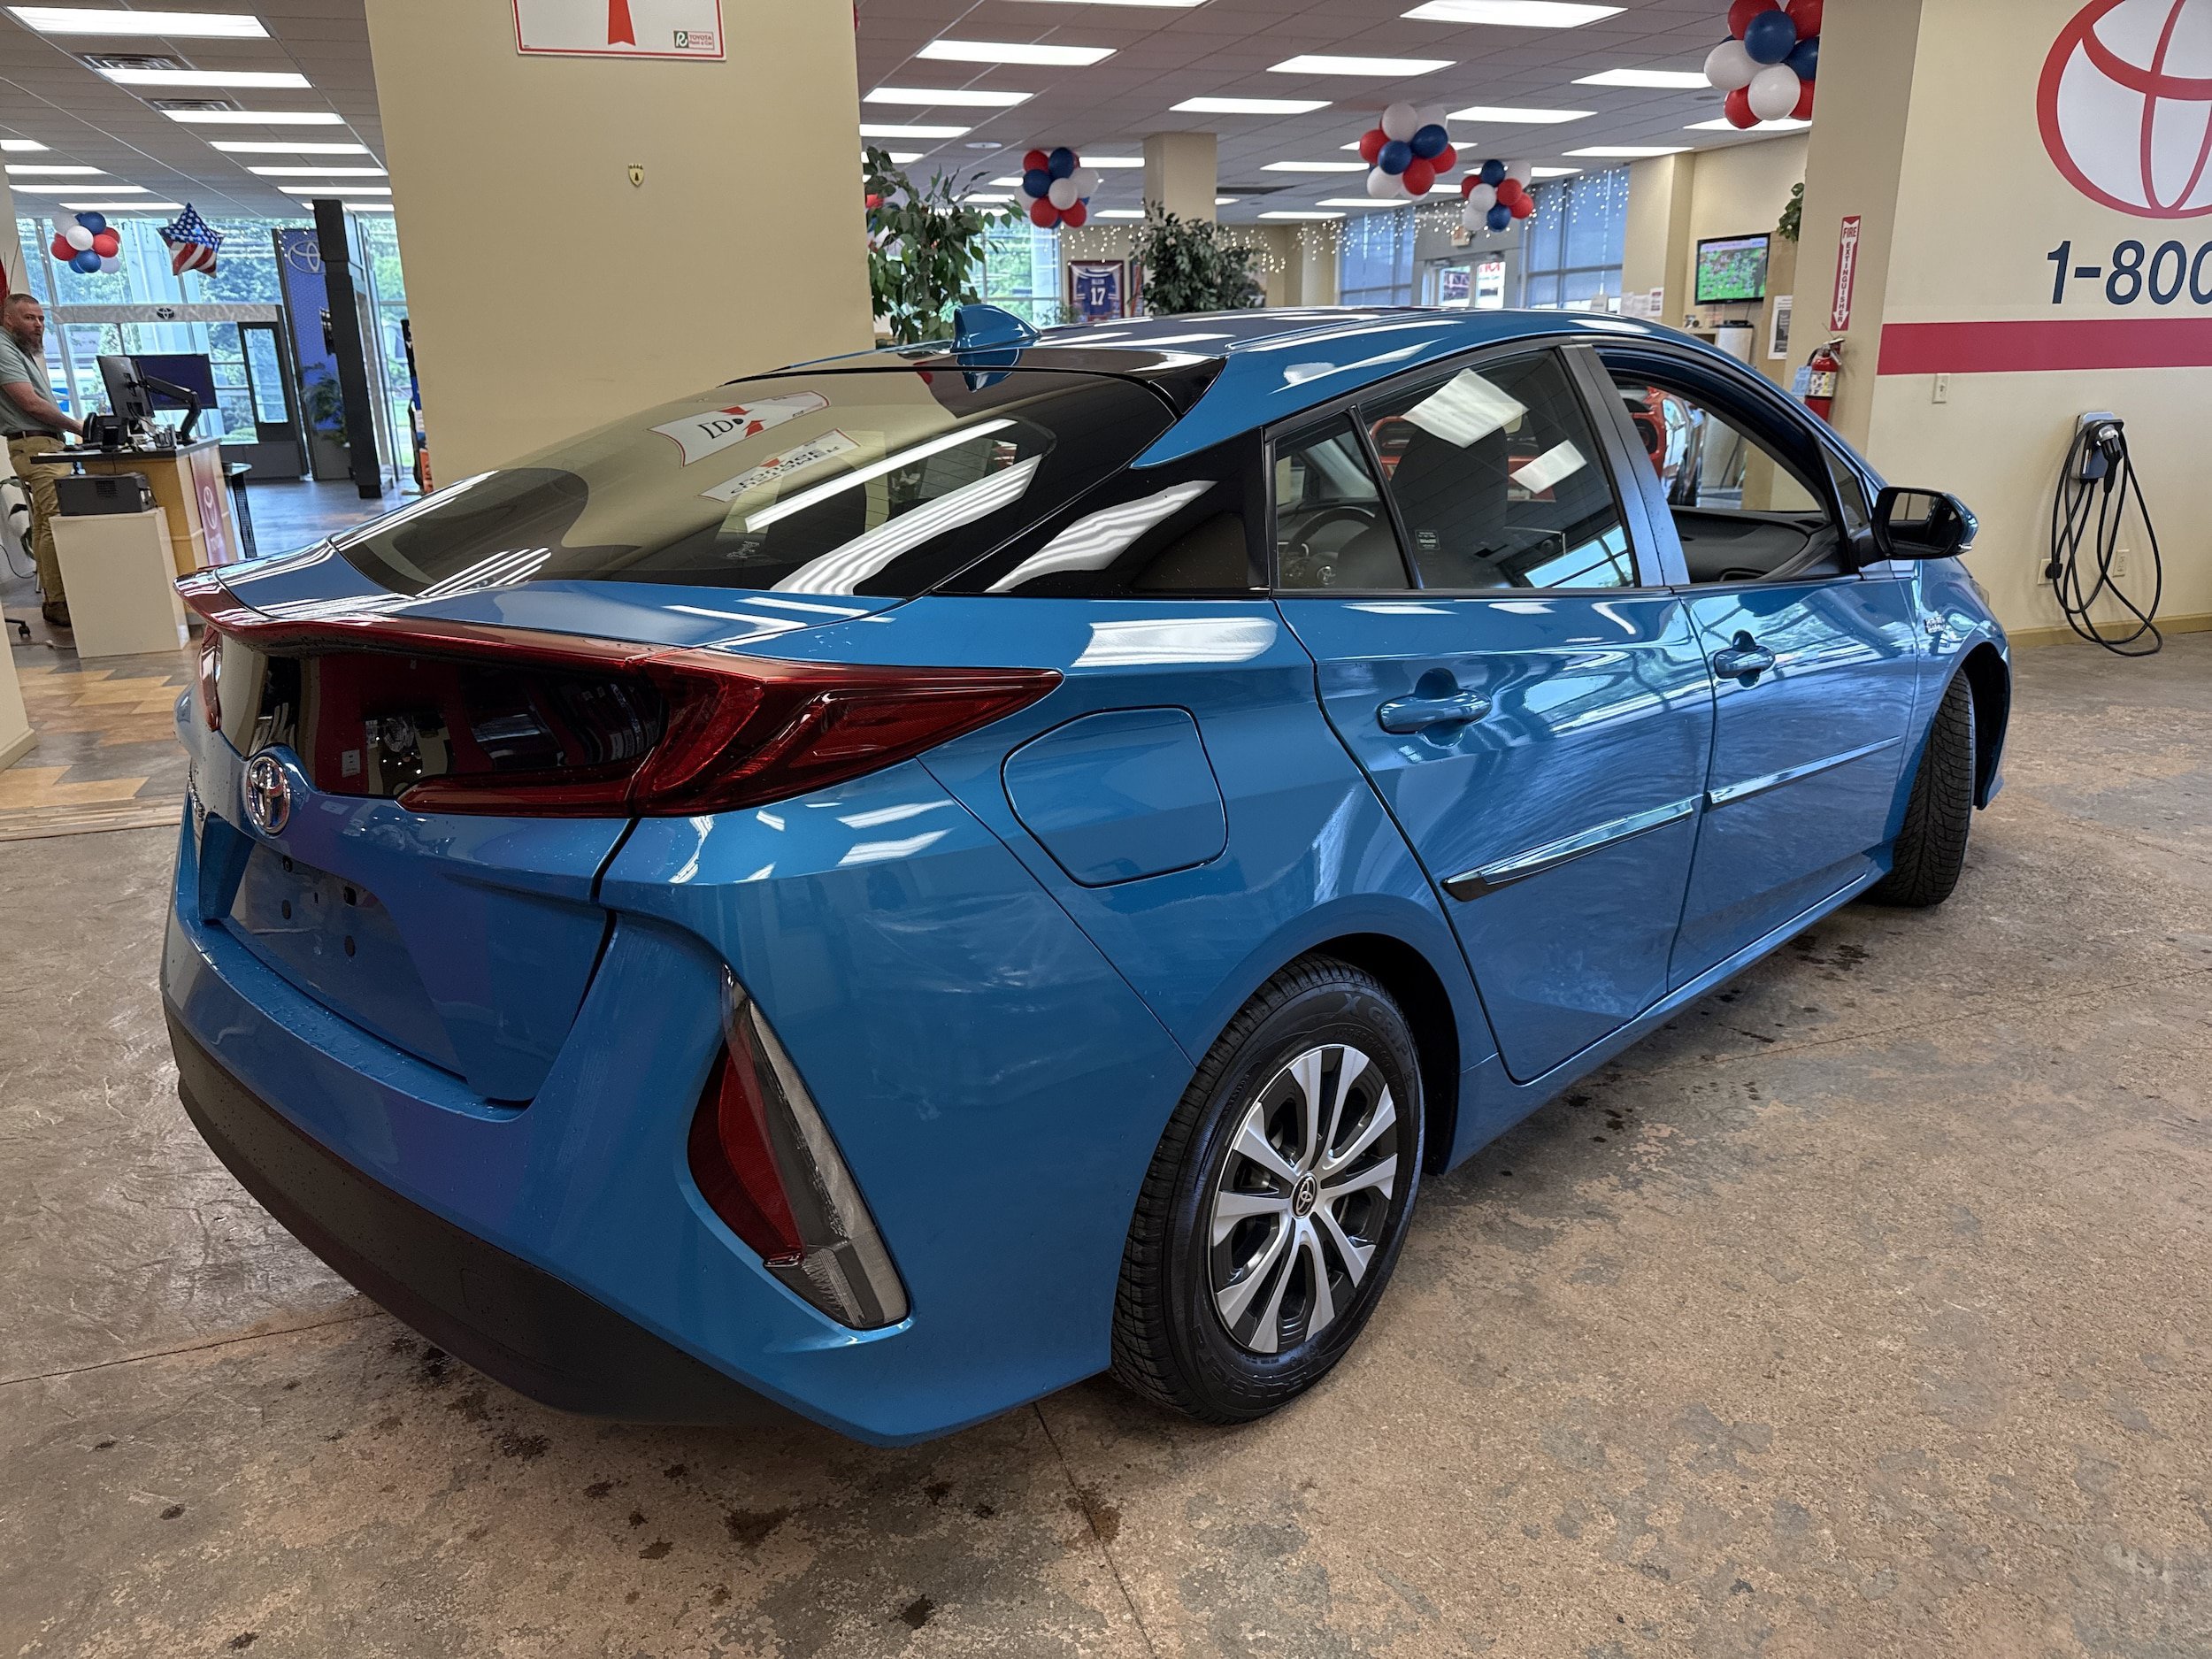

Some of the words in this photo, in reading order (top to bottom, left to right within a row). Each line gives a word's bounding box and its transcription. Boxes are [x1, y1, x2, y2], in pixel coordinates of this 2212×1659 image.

[1843, 227, 1857, 239] FIRE
[1838, 242, 1851, 322] EXTINGUISHER
[2047, 240, 2212, 305] 1-800
[1091, 287, 1105, 305] 17
